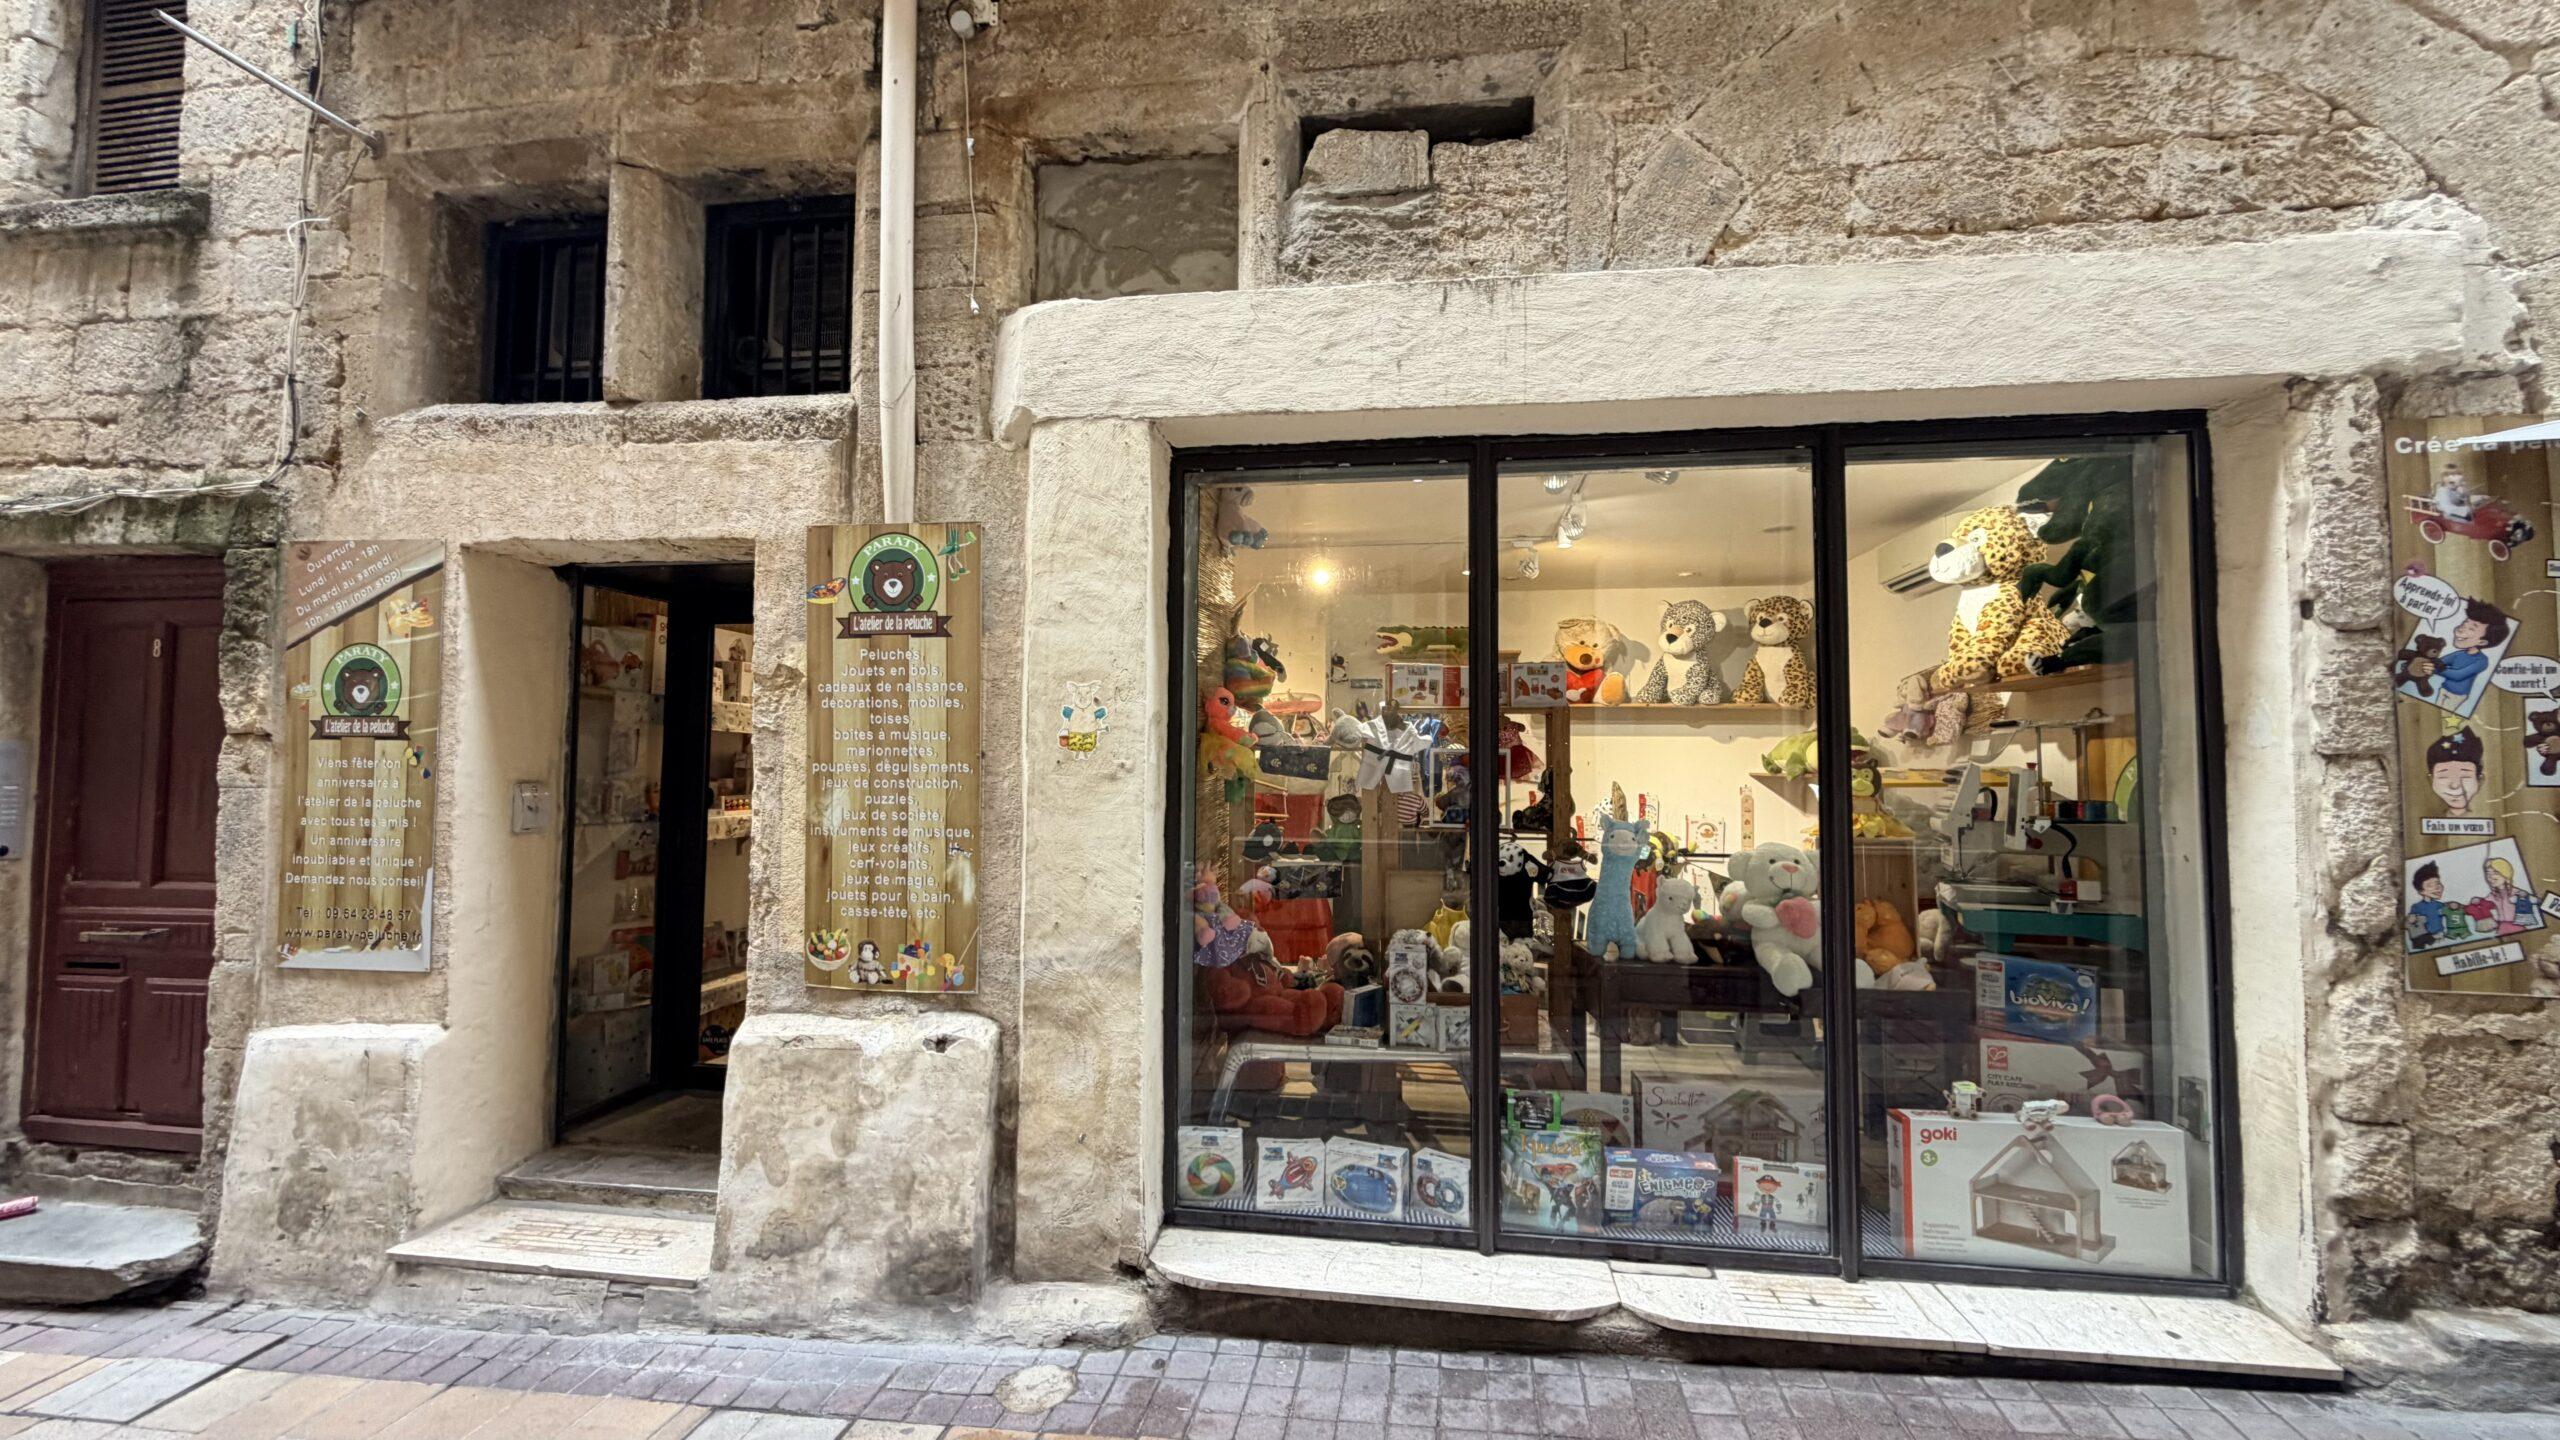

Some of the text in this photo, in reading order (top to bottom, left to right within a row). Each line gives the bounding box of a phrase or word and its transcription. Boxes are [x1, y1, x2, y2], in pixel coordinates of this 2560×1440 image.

[2395, 436, 2461, 453] Crée
[863, 537, 924, 556] PARATY
[307, 540, 356, 573] Ouverture
[296, 604, 312, 617] Du
[313, 584, 341, 608] mardi
[343, 577, 356, 590] au
[357, 553, 393, 581] samedi
[298, 574, 327, 597] Lundi
[335, 560, 354, 574] 14h
[305, 615, 324, 629] 10h
[352, 585, 373, 604] (non
[375, 567, 402, 589] stop)
[2398, 577, 2458, 607] Apprends-lui
[2407, 598, 2437, 615] parler
[853, 615, 933, 631] L'atelier de la peluche
[153, 638, 161, 657] 8
[334, 647, 390, 664] PARATY
[842, 664, 944, 677] Jouets en bois,
[817, 681, 968, 693] cadeaux de naissance,
[821, 697, 964, 710] décorations, mobiles,
[325, 719, 396, 735] L'atelier de la peluche
[870, 713, 915, 726] toises,
[879, 728, 886, 740] à
[890, 729, 951, 742] musique,
[847, 745, 939, 758] marionnettes,
[317, 757, 401, 769] Viens fêter ton
[812, 759, 973, 775] poupées, déguisements,
[316, 777, 399, 789] anniversaire à
[821, 776, 963, 791] jeux de construction,
[298, 795, 422, 810] l'atelier de la peluche
[865, 793, 919, 806] puzzles,
[300, 816, 327, 826] avec
[331, 817, 356, 826] tous
[360, 817, 376, 827] tes
[381, 816, 409, 827] amis
[871, 808, 887, 821] de
[891, 808, 944, 822] société,
[810, 824, 974, 840] instruments de musique,
[2425, 820, 2446, 831] Fais
[311, 834, 401, 847] Un anniversaire
[848, 840, 935, 854] jeux créatifs,
[292, 853, 356, 865] inoubliable
[360, 856, 370, 866] et
[374, 855, 415, 868] unique
[849, 857, 934, 871] cerf-volants,
[285, 872, 424, 888] Demandez nous conseil
[842, 873, 939, 889] jeux de magie,
[826, 888, 955, 904] jouets pour le bain,
[840, 905, 941, 919] casse-tête, etc.
[2452, 949, 2501, 970] Habille-le
[1920, 1127, 1957, 1144] goki
